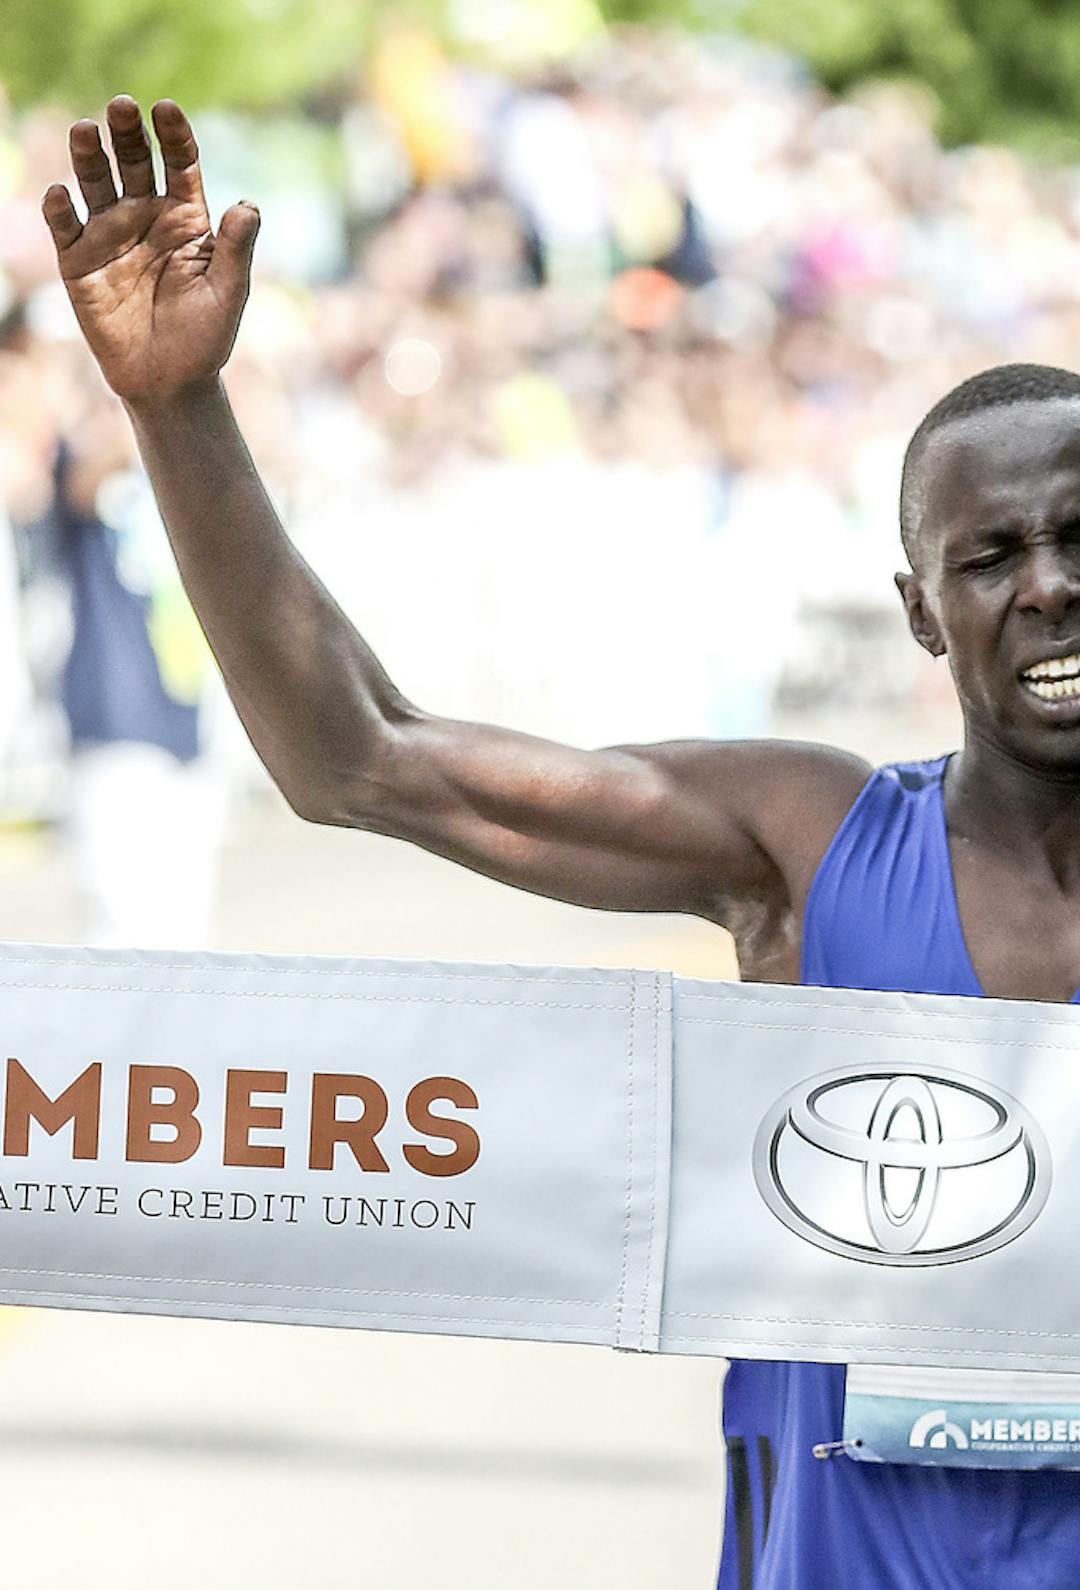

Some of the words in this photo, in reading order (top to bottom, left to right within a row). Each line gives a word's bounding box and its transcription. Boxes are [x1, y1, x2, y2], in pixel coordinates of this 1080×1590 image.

[3, 1058, 479, 1177] MBERS
[138, 1189, 306, 1222] CREDIT
[323, 1197, 477, 1230] UNION
